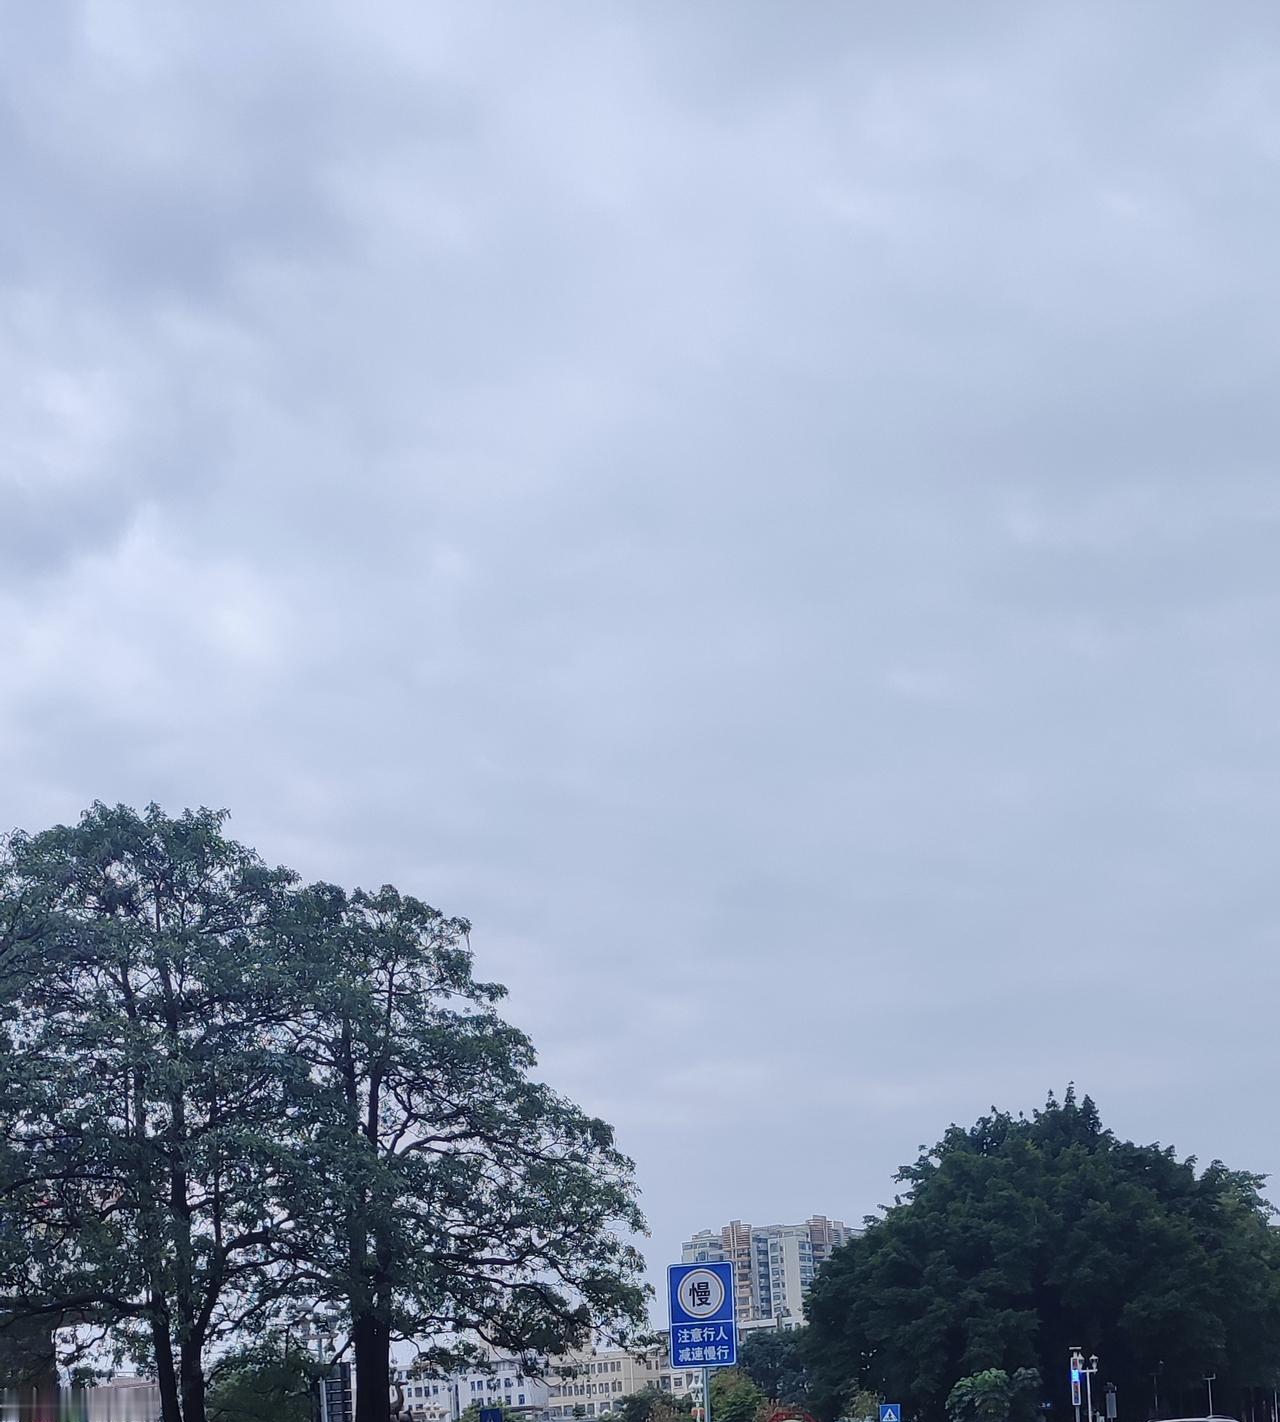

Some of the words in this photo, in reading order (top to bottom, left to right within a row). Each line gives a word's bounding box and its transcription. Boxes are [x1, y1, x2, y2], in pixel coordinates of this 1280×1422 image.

[688, 1282, 711, 1307] 慢
[677, 1326, 728, 1343] 注意行人
[678, 1345, 730, 1362] 减速慢行
